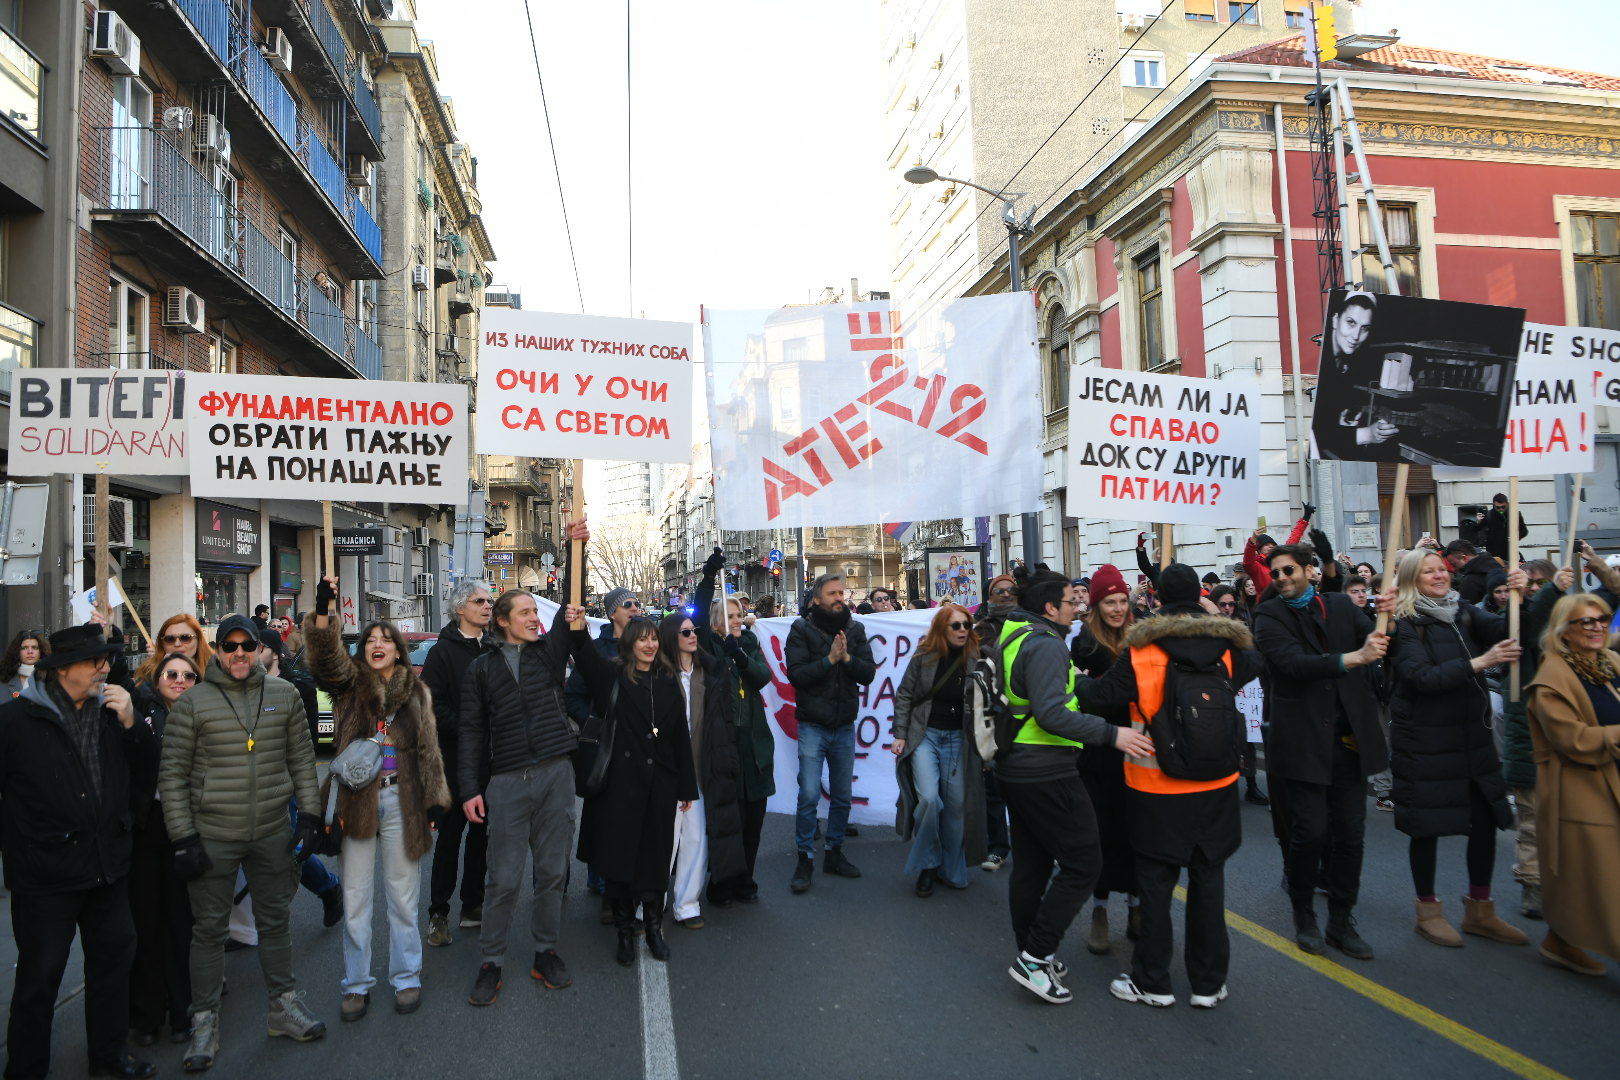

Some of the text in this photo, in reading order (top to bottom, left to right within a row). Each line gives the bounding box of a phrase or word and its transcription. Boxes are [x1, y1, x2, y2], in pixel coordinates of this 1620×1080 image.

[485, 331, 690, 362] ИЗ НАШИХ ТУЖНИХ СОБА
[495, 368, 668, 403] ОЧИ У ОЧИ
[1078, 376, 1250, 418] ЈЕСАМ ЛИ ЈА
[198, 390, 454, 426] ФУНДАМЕНТАЛНО
[501, 404, 671, 440] СА СВЕТОМ
[20, 425, 184, 458] SOLIDARAN
[208, 422, 453, 457] ОБРАТИ ПАЖЊУ
[1109, 413, 1219, 445] СПАВАО
[215, 454, 443, 487] НА ПОНАШАЊЕ
[1079, 441, 1247, 481] ДОК СУ ДРУГИ
[1100, 474, 1222, 506] ПАТИЛИ?
[202, 535, 231, 548] UNITECH
[236, 531, 258, 544] BEAUTY
[236, 543, 252, 555] SHOP
